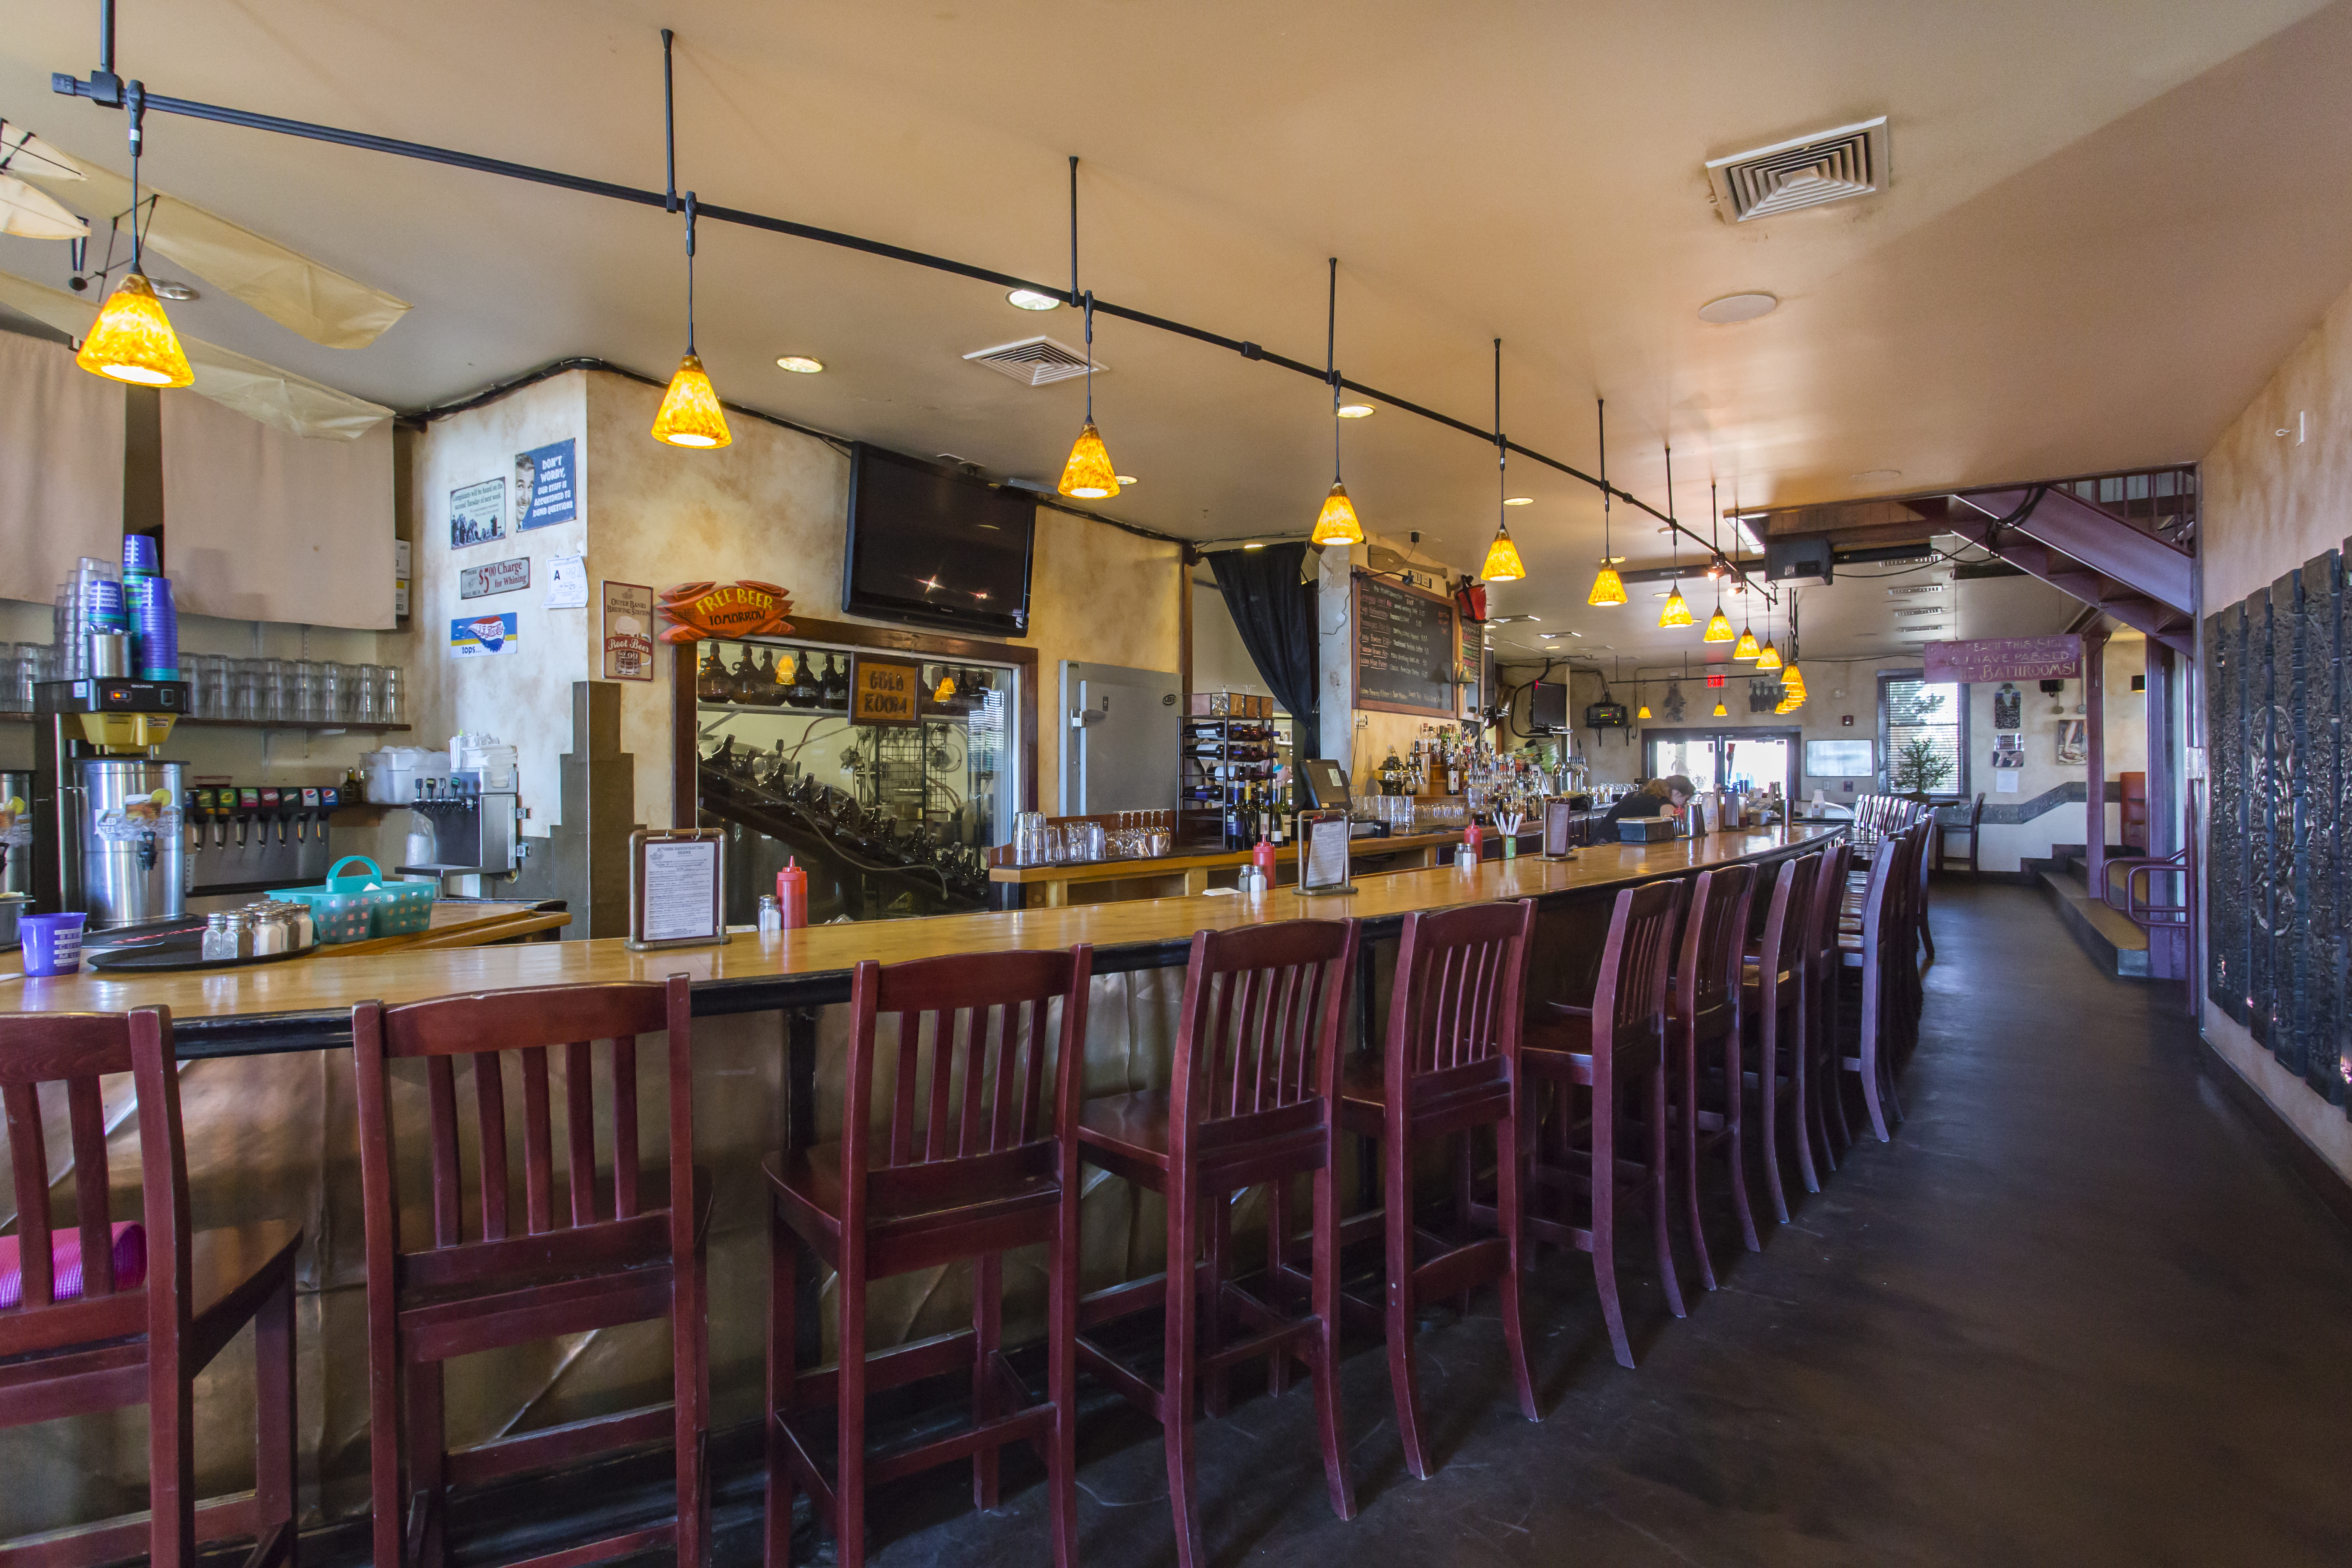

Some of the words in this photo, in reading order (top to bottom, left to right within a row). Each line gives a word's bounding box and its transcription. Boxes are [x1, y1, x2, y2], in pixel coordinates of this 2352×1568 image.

[542, 455, 562, 470] DON'T
[540, 467, 566, 483] WORRY,
[453, 493, 471, 502] Complaints
[483, 484, 492, 493] heard
[538, 486, 548, 495] OUR
[548, 482, 561, 493] STAFF
[562, 480, 567, 488] IS
[455, 501, 466, 510] second
[467, 498, 480, 507] Tuesday
[534, 492, 564, 506] ACCUSTOMED
[564, 490, 571, 498] TO
[533, 507, 547, 517] DUMB
[548, 500, 573, 514] QUESTIONS
[498, 562, 522, 575] Charge
[554, 570, 560, 581] A
[504, 575, 527, 585] Whining
[607, 605, 631, 614] BREWING
[695, 588, 733, 616] FREE
[737, 588, 773, 611] BEER
[709, 610, 766, 626] TOMORROW
[608, 638, 628, 650] Root
[629, 639, 649, 653] Beer
[2005, 640, 2029, 649] THIS
[1973, 654, 2009, 663] HAVE
[1980, 662, 2075, 682] BATHROOMS!
[1707, 675, 1725, 687] EXIT
